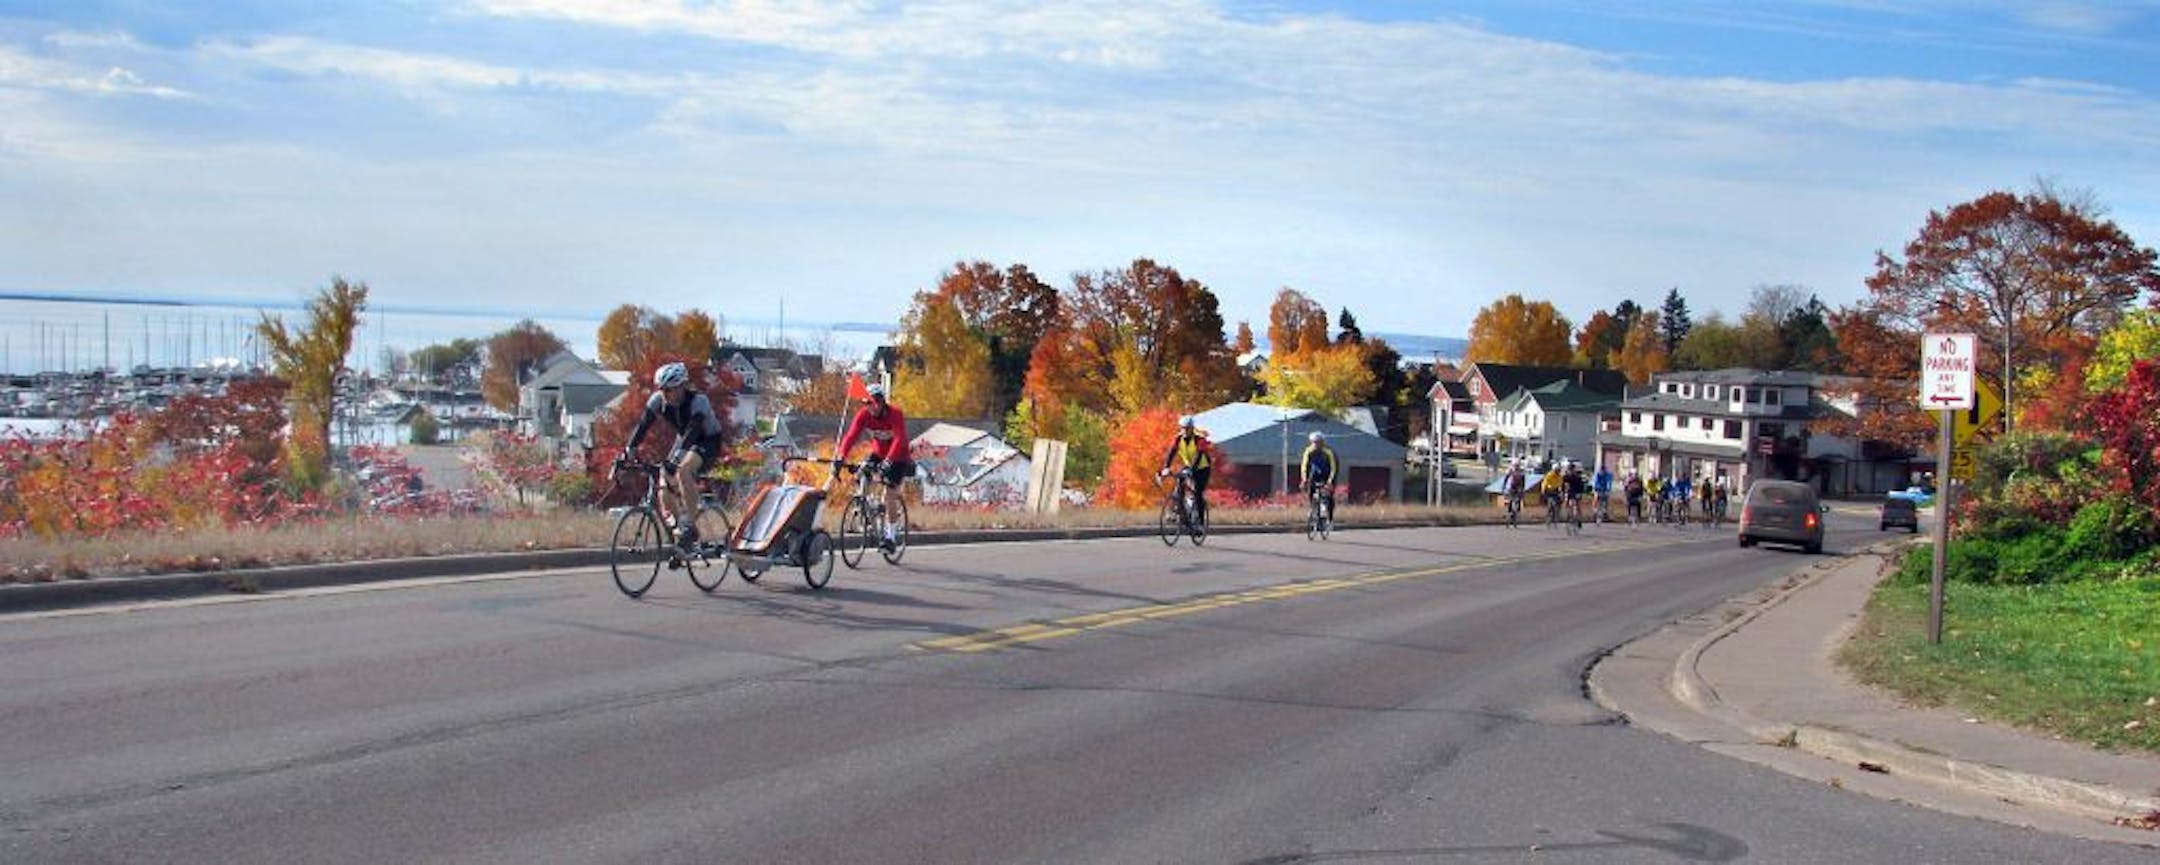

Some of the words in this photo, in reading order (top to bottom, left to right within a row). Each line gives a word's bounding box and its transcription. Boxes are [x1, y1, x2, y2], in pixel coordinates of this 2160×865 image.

[1940, 340, 1957, 355] NO
[1926, 356, 1969, 371] PARKING
[1938, 373, 1955, 382] ANY
[1937, 383, 1956, 393] TIME
